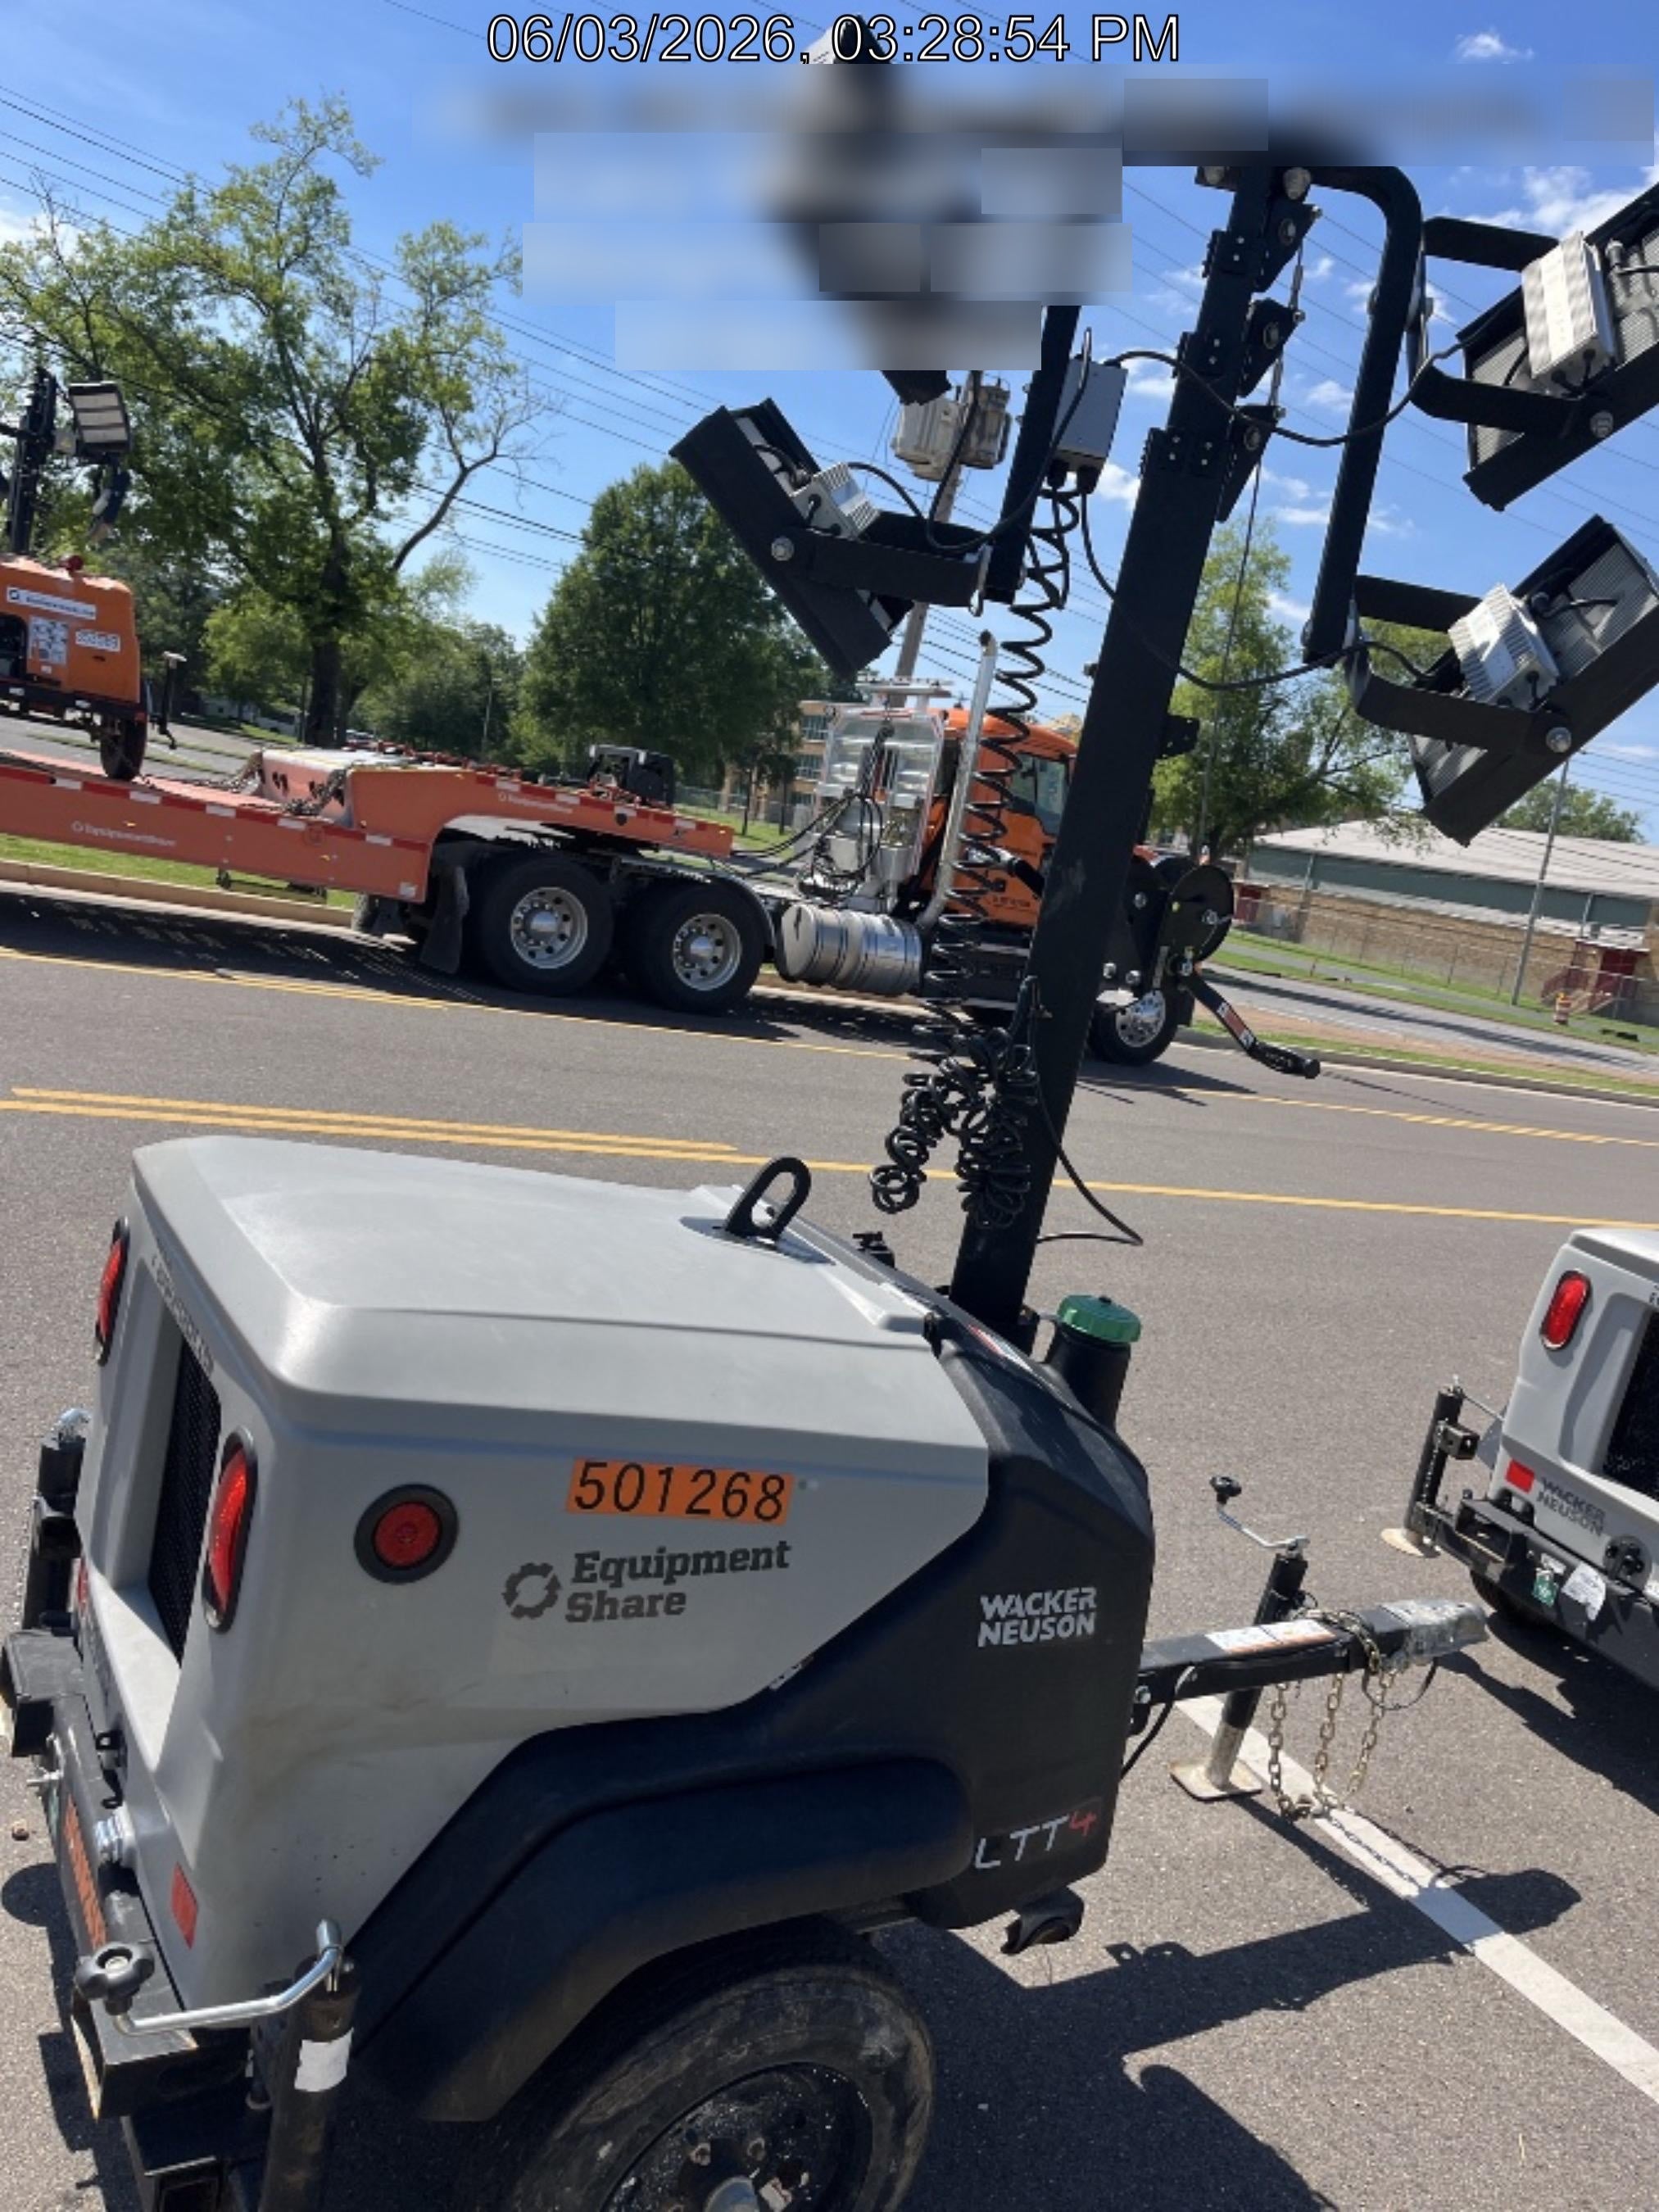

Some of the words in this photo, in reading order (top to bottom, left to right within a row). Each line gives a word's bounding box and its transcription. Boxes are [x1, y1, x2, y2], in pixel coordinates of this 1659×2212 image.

[573, 1461, 786, 1522] 501268
[1536, 1491, 1605, 1537] NEUSON
[1542, 1477, 1606, 1521] WACKER
[570, 1540, 791, 1589] Equipment
[564, 1588, 687, 1623] Share
[979, 1586, 1097, 1621] WACKER
[977, 1612, 1096, 1648] NEUSON
[974, 1810, 1098, 1870] LTT4
